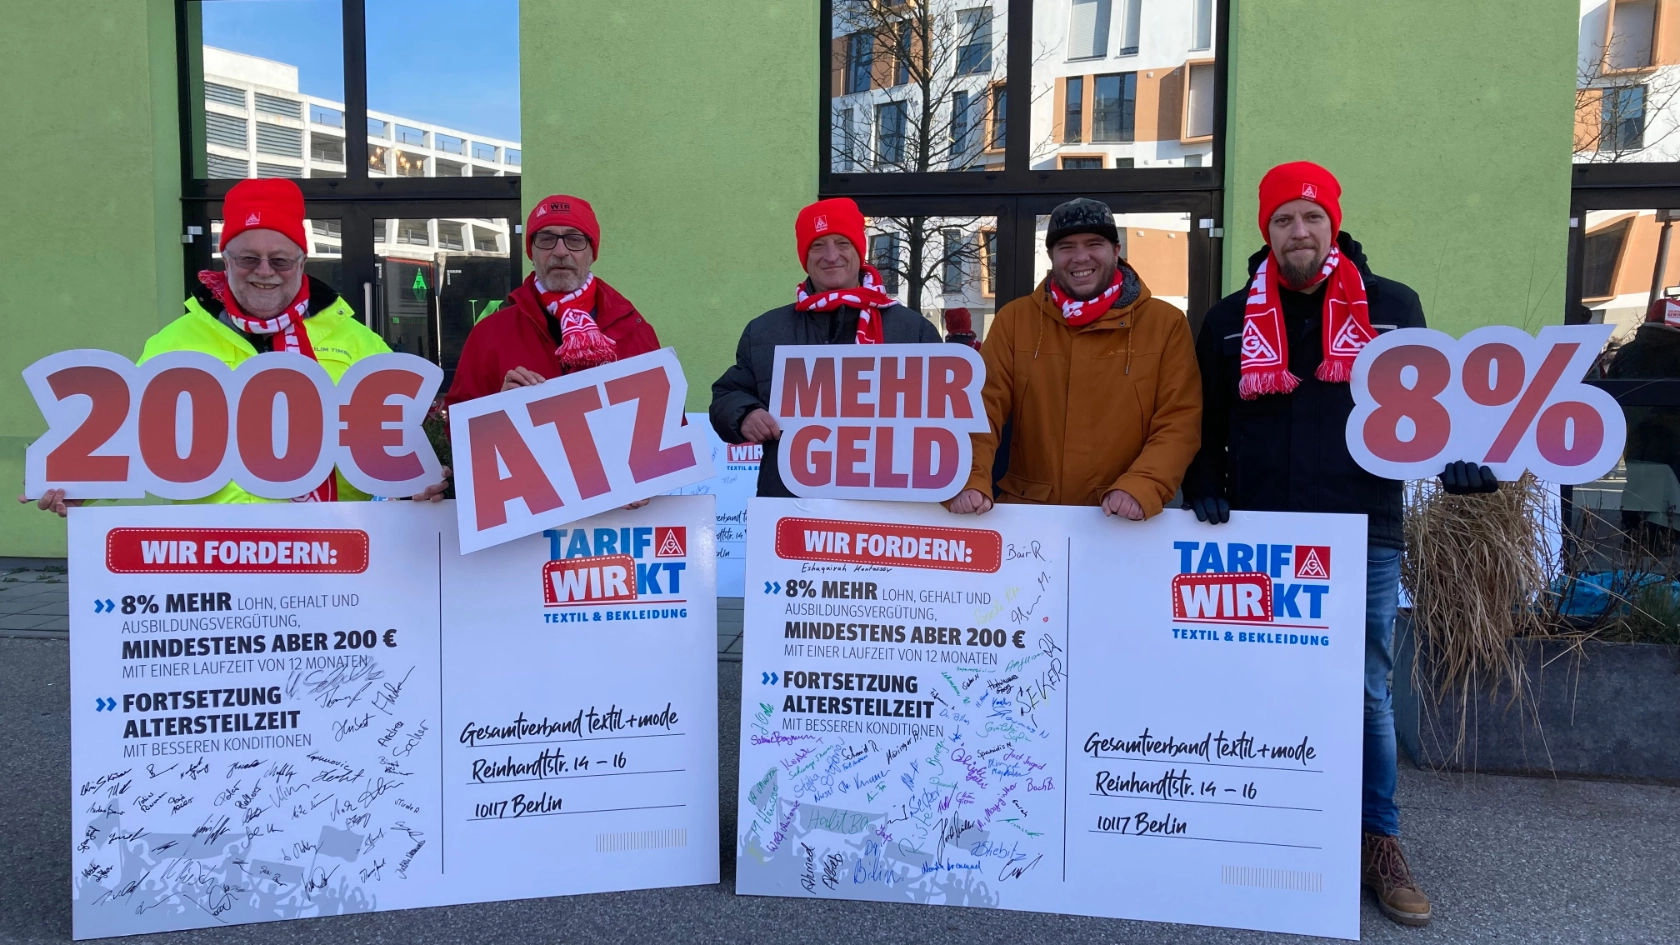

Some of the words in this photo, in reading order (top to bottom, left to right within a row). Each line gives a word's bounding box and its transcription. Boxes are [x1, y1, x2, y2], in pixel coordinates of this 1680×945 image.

[780, 356, 974, 419] MEHR
[1363, 342, 1604, 467] 8%
[46, 366, 425, 483] 200€
[468, 366, 697, 532] ATZ
[789, 424, 959, 489] GELD
[141, 540, 197, 565] WIR
[204, 541, 338, 565] FORDERN:
[543, 527, 653, 561] TARIF
[804, 530, 850, 555] WIR
[856, 533, 972, 563] FORDERN:
[1174, 541, 1293, 578] TARIF
[121, 595, 159, 615] 8%
[165, 592, 232, 613] MEHR
[238, 597, 276, 612] LOHN,
[280, 595, 328, 609] GEHALT
[332, 594, 359, 607] UND
[785, 579, 816, 598] 8%
[822, 581, 877, 600] MEHR
[882, 588, 916, 603] LOHN,
[920, 589, 962, 603] GEHALT
[966, 592, 991, 605] UND
[121, 614, 301, 634] AUSBILDUNGSVERGÜTUNG,
[544, 612, 589, 623] TEXTIL
[593, 611, 602, 621] &
[606, 608, 687, 622] BEKLEIDUNG
[785, 602, 937, 622] AUSBILDUNGSVERGÜTUNG,
[122, 634, 266, 660] MINDESTENS
[272, 632, 328, 653] ABER
[333, 630, 377, 650] 200
[383, 629, 397, 648] €
[784, 621, 905, 643] MINDESTENS
[910, 627, 961, 645] ABER
[967, 628, 1007, 647] 200
[1012, 630, 1026, 648] €
[1172, 629, 1220, 641] TEXTIL
[1224, 631, 1234, 642] &
[1239, 632, 1329, 646] BEKLEIDUNG
[122, 664, 147, 679] MIT
[151, 662, 190, 678] EINER
[193, 659, 255, 675] LAUFZEIT
[259, 658, 286, 672] VON
[290, 657, 302, 671] 12
[306, 655, 368, 670] MONATEN
[784, 644, 804, 657] MIT
[808, 645, 839, 659] EINER
[843, 646, 893, 661] LAUFZEIT
[898, 648, 922, 663] VON
[926, 650, 938, 663] 12
[941, 651, 998, 666] MONATEN
[784, 670, 918, 694] FORTSETZUNG
[123, 686, 281, 713] FORTSETZUNG
[783, 695, 934, 719] ALTERSTEILZEIT
[123, 710, 300, 739] ALTERSTEILZEIT
[460, 710, 583, 746] Gesamtverband
[585, 702, 678, 733] textil+mode
[782, 718, 802, 731] MIT
[806, 718, 862, 734] BESSEREN
[866, 722, 944, 738] KONDITIONEN
[123, 743, 148, 758] MIT
[152, 739, 220, 756] BESSEREN
[224, 734, 312, 752] KONDITIONEN
[1083, 728, 1212, 762] Gesamtverband
[1213, 730, 1317, 766] textil+mode
[473, 748, 568, 783] Reinhardtstr.
[574, 757, 589, 771] 14
[613, 752, 627, 768] 16
[1096, 768, 1195, 799] Reinhardtstr.
[1200, 781, 1217, 796] 14
[1243, 782, 1258, 800] 16
[475, 801, 508, 819] 10117
[511, 792, 562, 818] Berlin
[1097, 815, 1131, 835] 10117
[1134, 811, 1187, 835] Berlin
